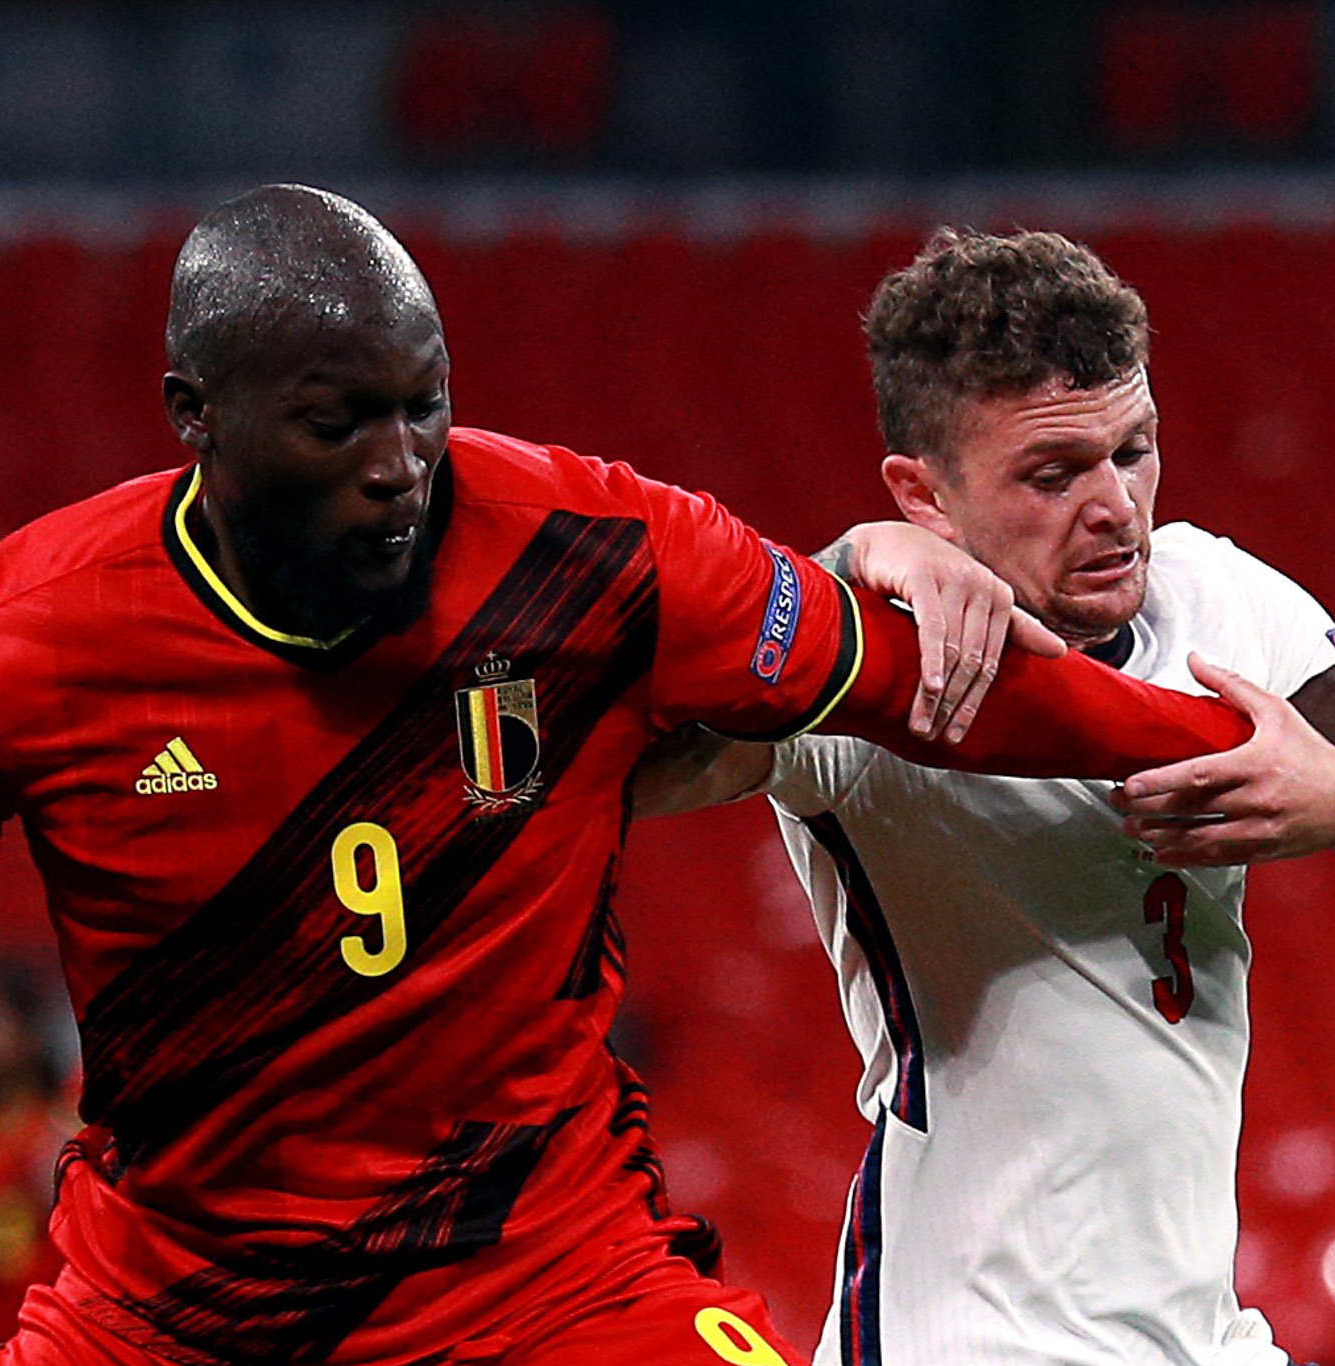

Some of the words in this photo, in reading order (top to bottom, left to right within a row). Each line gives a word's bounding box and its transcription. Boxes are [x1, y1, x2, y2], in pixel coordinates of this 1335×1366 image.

[134, 772, 219, 796] adidas
[330, 821, 408, 977] 9
[1143, 871, 1195, 1025] 3
